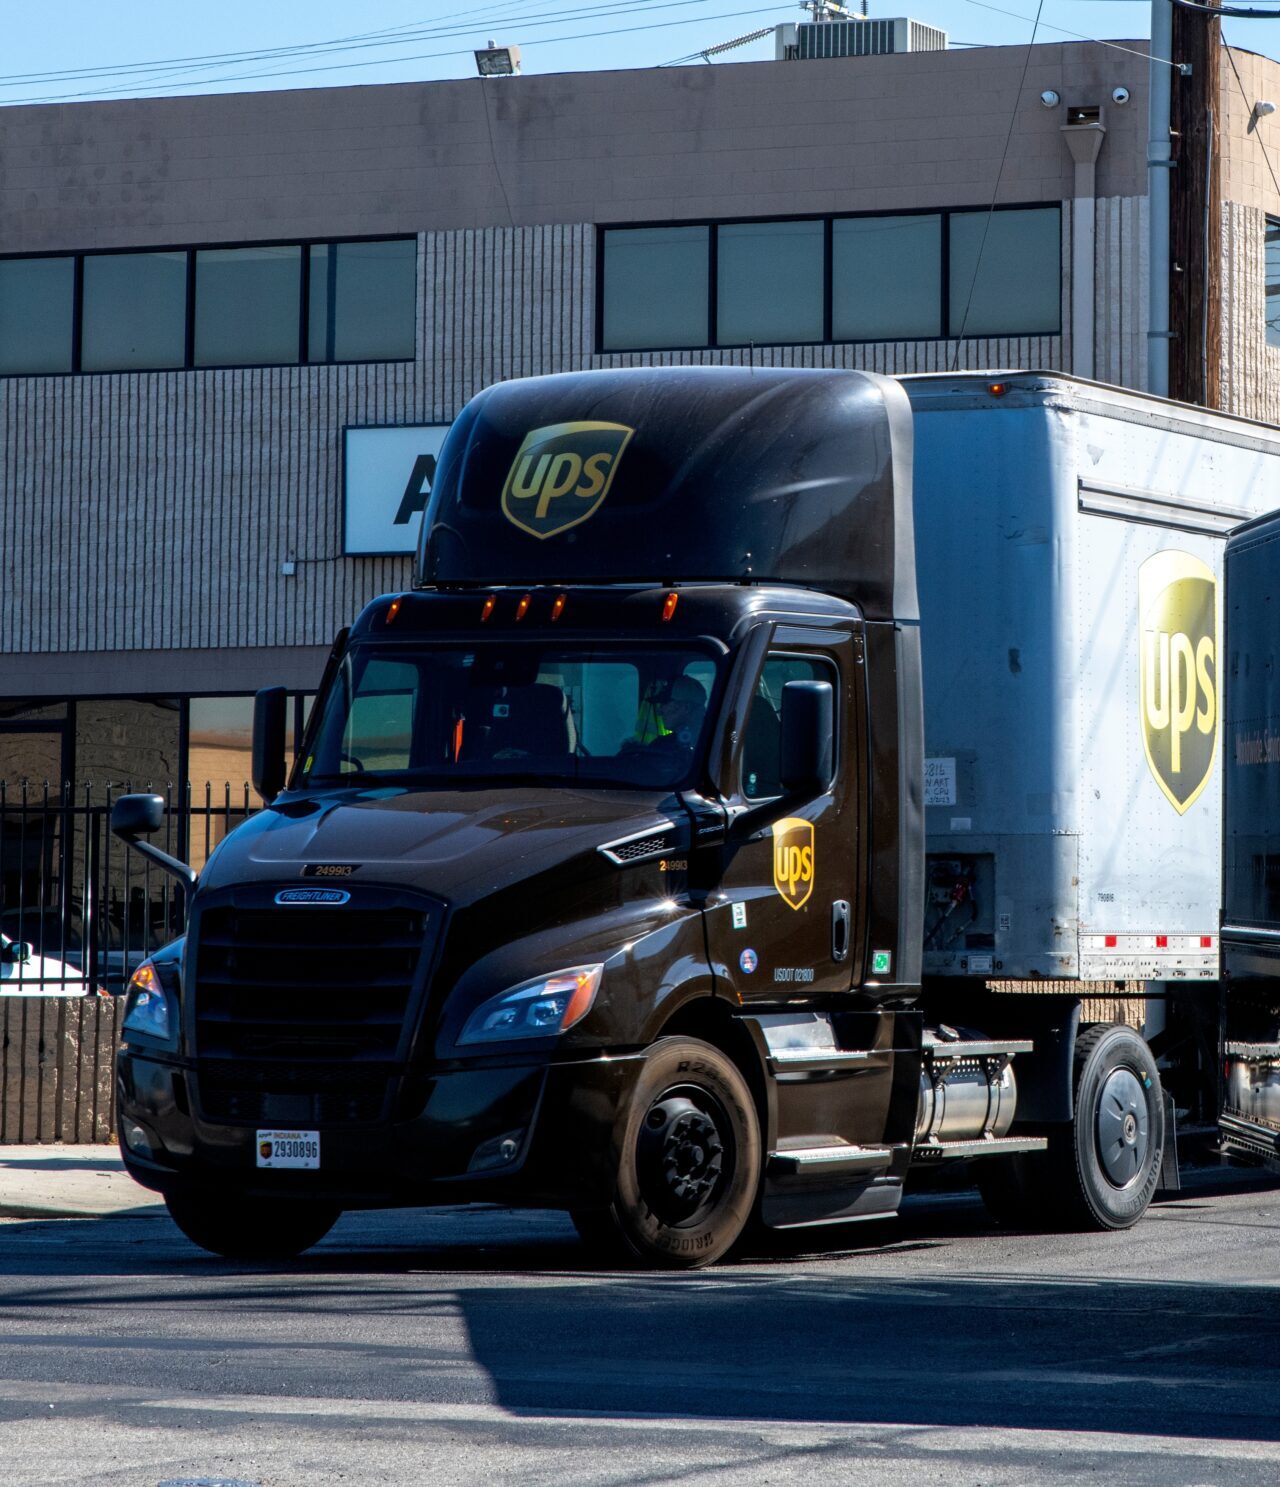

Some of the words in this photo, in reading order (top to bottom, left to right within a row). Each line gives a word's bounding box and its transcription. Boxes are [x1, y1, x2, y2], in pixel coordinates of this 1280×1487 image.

[511, 452, 613, 518] ups
[1146, 631, 1215, 773] ups
[315, 866, 352, 876] 249913
[777, 846, 811, 895] ups
[281, 891, 342, 901] FREIGHTLINER
[274, 1141, 317, 1158] 2930896
